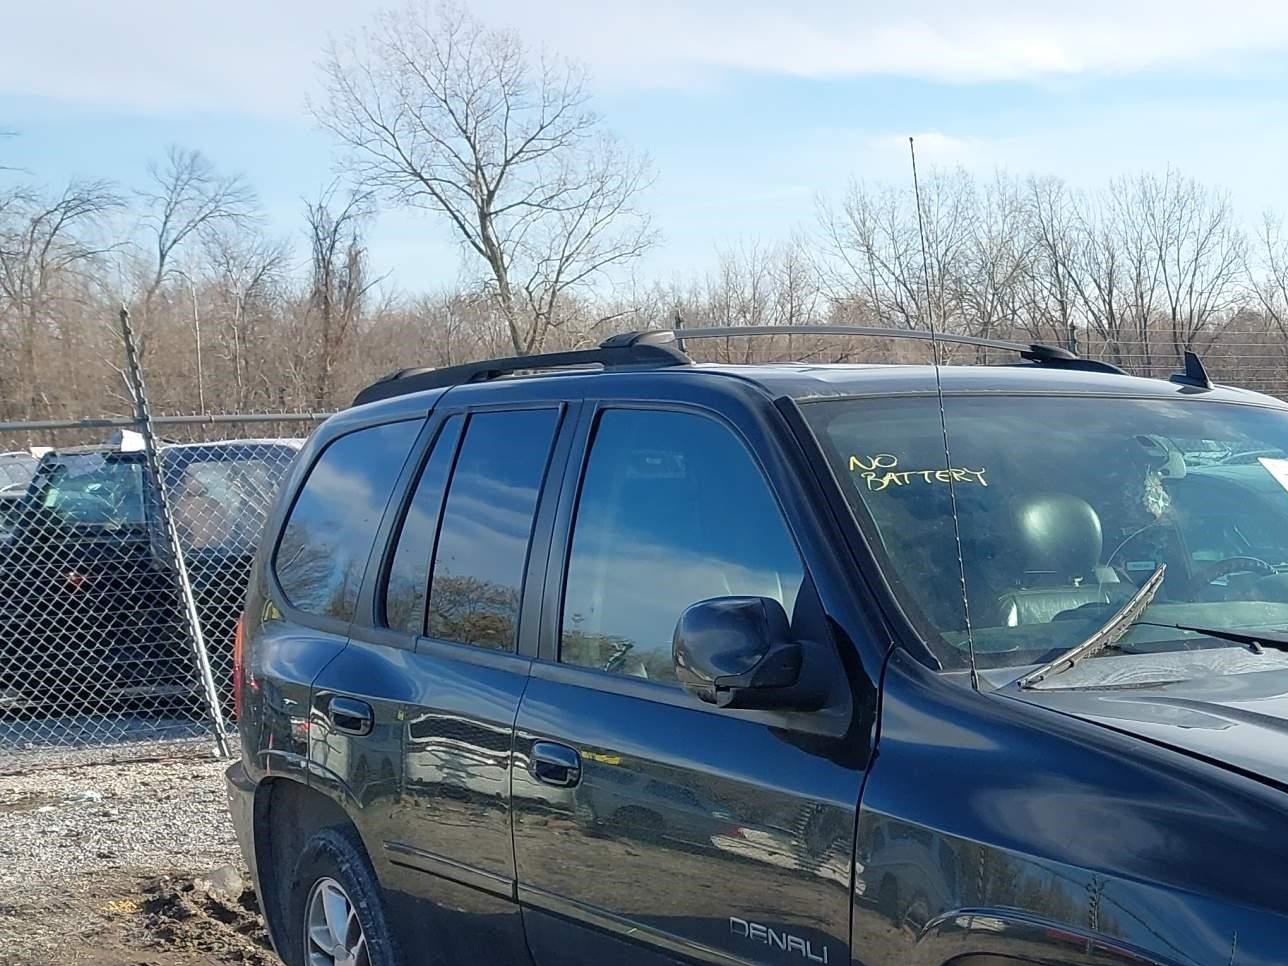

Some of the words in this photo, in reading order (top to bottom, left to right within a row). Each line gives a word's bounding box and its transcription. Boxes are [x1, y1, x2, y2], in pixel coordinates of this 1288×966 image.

[849, 453, 898, 471] NO
[860, 467, 988, 491] BATTERY
[729, 916, 828, 964] DENALI
